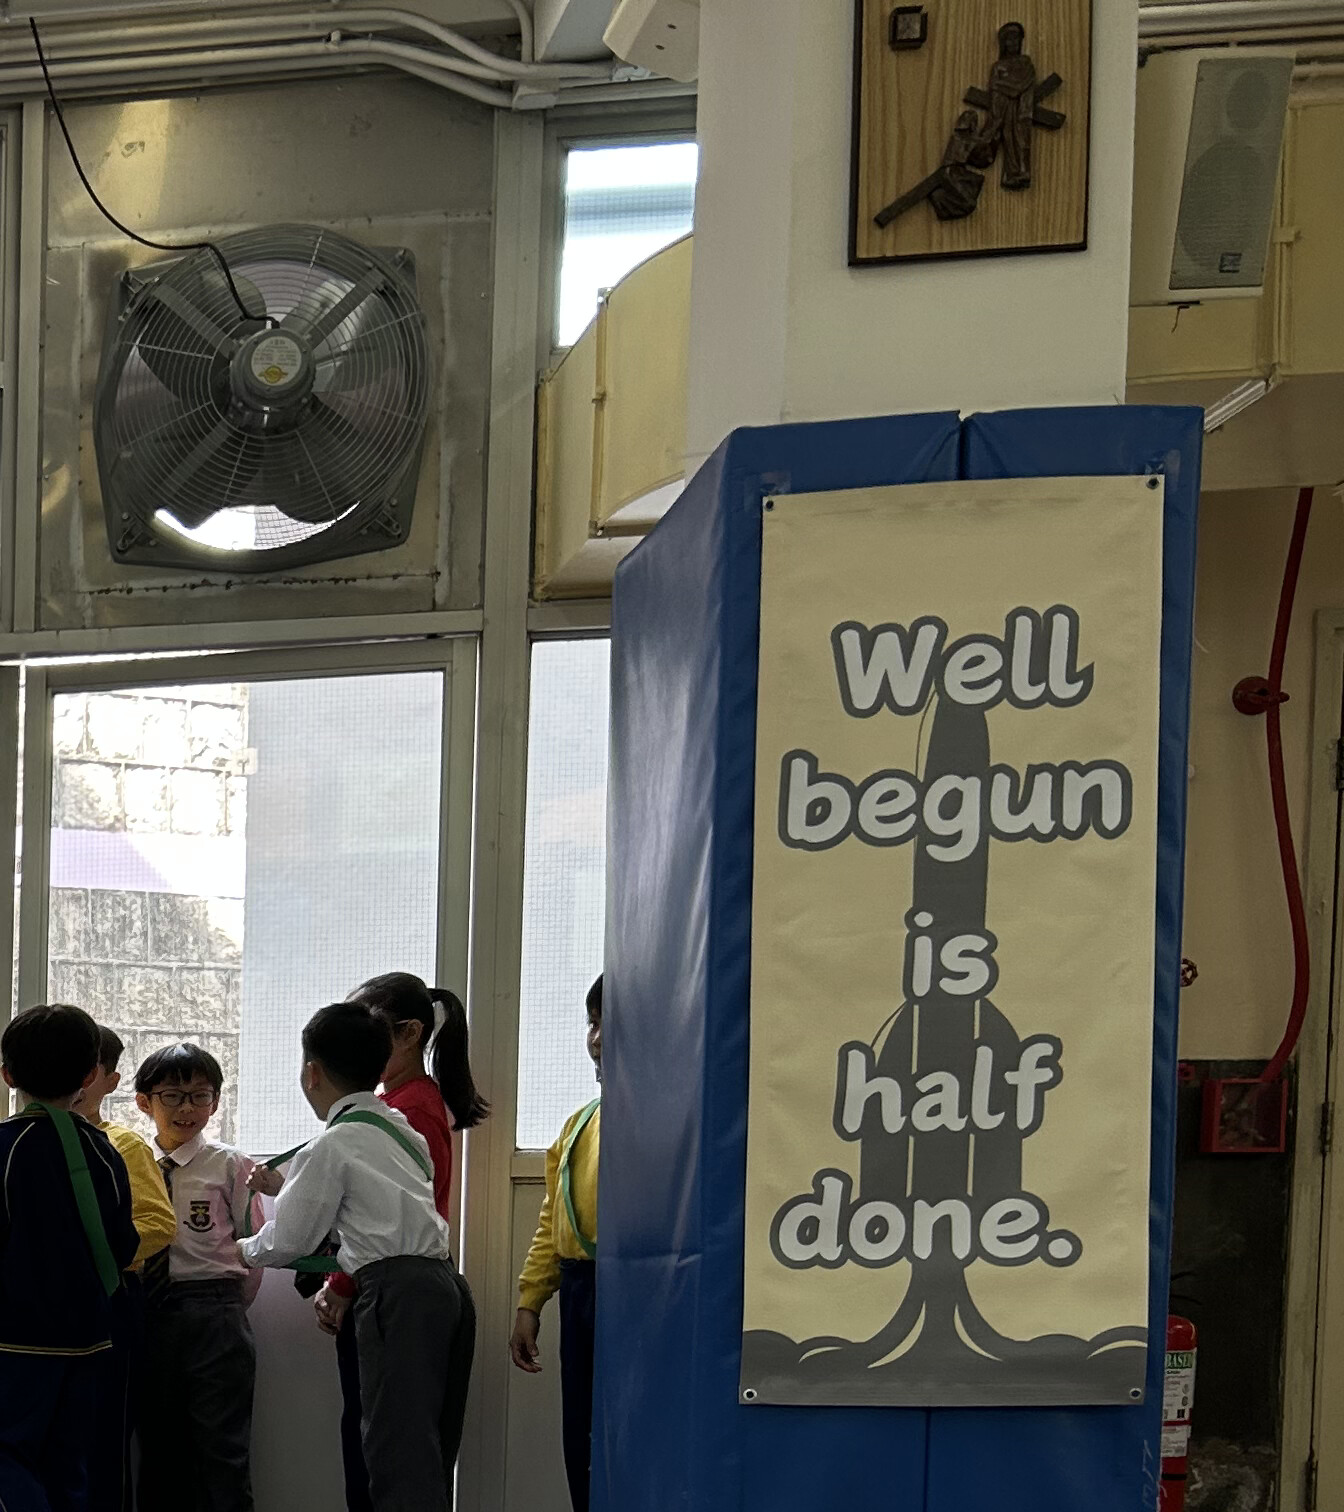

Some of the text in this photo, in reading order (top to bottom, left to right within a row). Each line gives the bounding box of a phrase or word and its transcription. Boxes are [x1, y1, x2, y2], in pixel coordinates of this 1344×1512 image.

[834, 606, 1091, 717] Well
[780, 751, 1131, 867] begun
[907, 906, 995, 1003] is
[835, 1036, 1061, 1138] half
[773, 1169, 1081, 1267] done.
